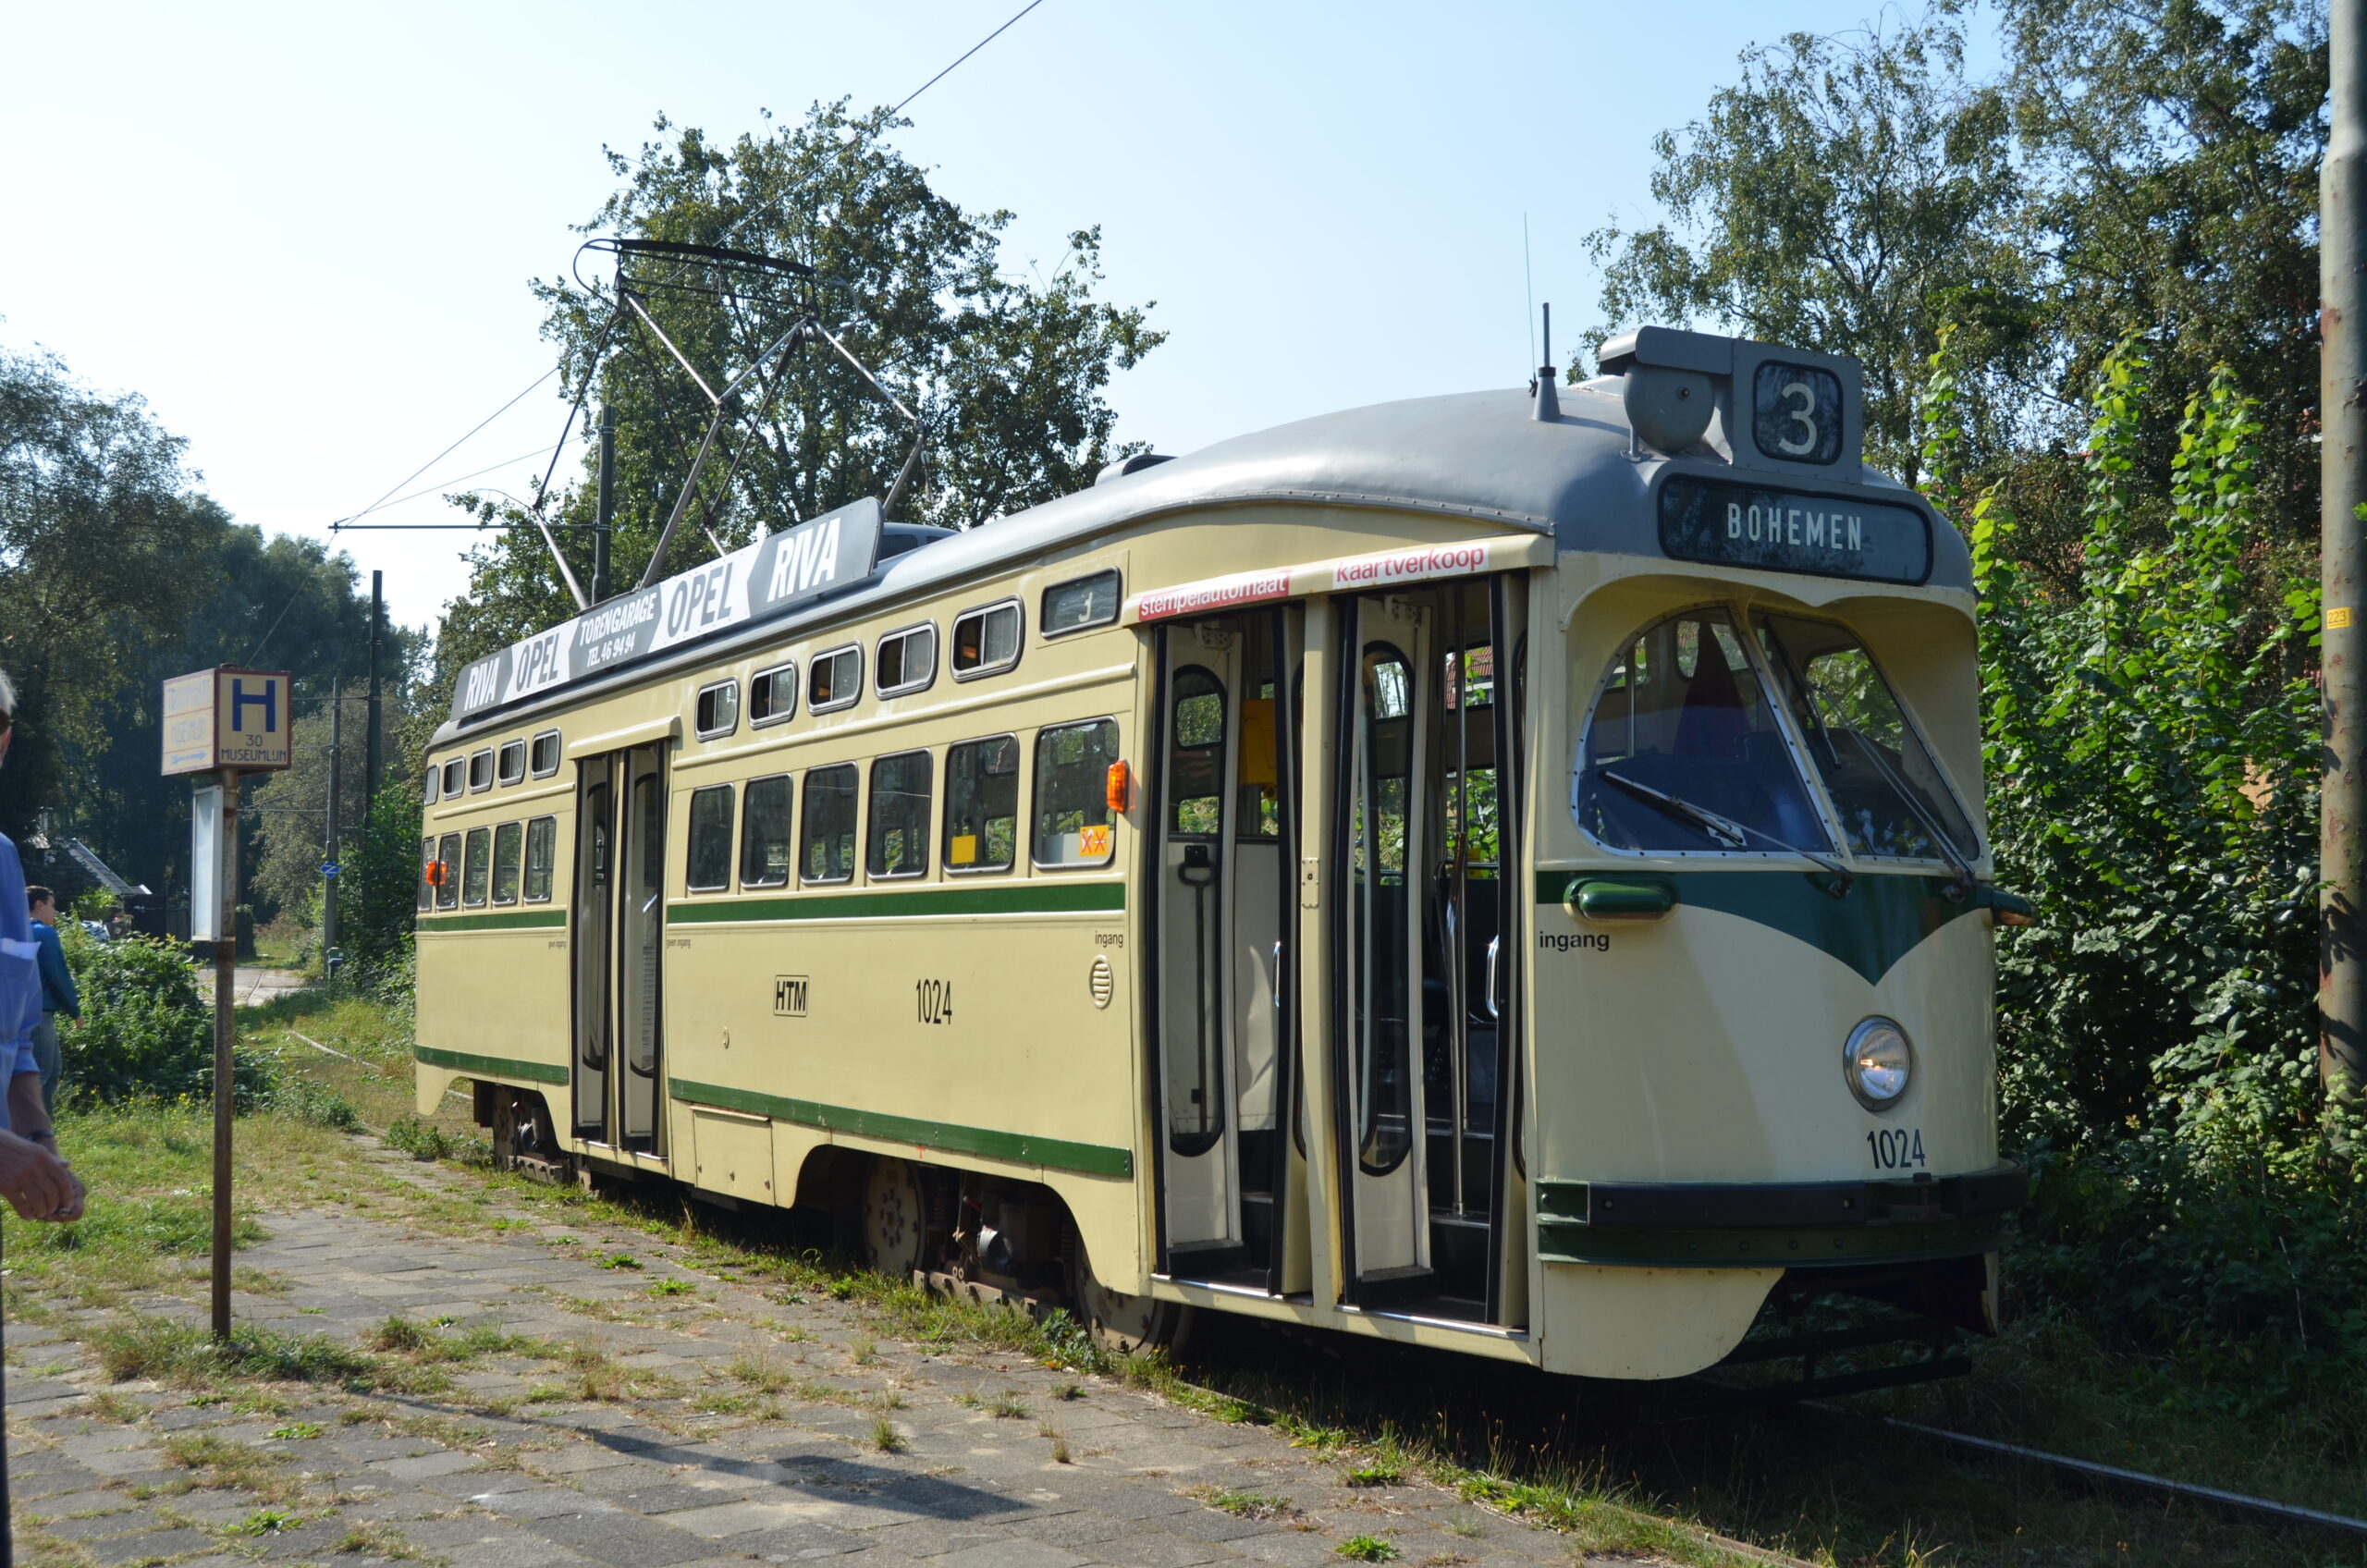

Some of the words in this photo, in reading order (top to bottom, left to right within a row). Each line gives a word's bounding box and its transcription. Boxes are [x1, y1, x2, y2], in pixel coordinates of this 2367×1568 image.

[1778, 382, 1817, 456] 3
[1727, 502, 1861, 551] BOHEMEN
[767, 517, 840, 603] RIVA
[1336, 546, 1484, 583] kaartverkoop
[579, 592, 656, 646] TORENGARAGE
[668, 562, 733, 639] OPEL
[2328, 610, 2347, 624] 223
[516, 633, 560, 692] OPEL
[586, 646, 601, 668] TEL.
[601, 641, 612, 662] 46
[612, 636, 625, 657] 94
[624, 631, 636, 653] 94
[232, 678, 276, 732] H
[463, 656, 501, 711] RIVA
[221, 748, 287, 763] MUSEUMLIJN
[245, 734, 264, 748] 30
[1095, 930, 1124, 949] ingang
[1539, 930, 1610, 952] ingang
[775, 981, 807, 1011] HTM
[916, 978, 952, 1025] 1024
[1867, 1128, 1926, 1170] 1024
